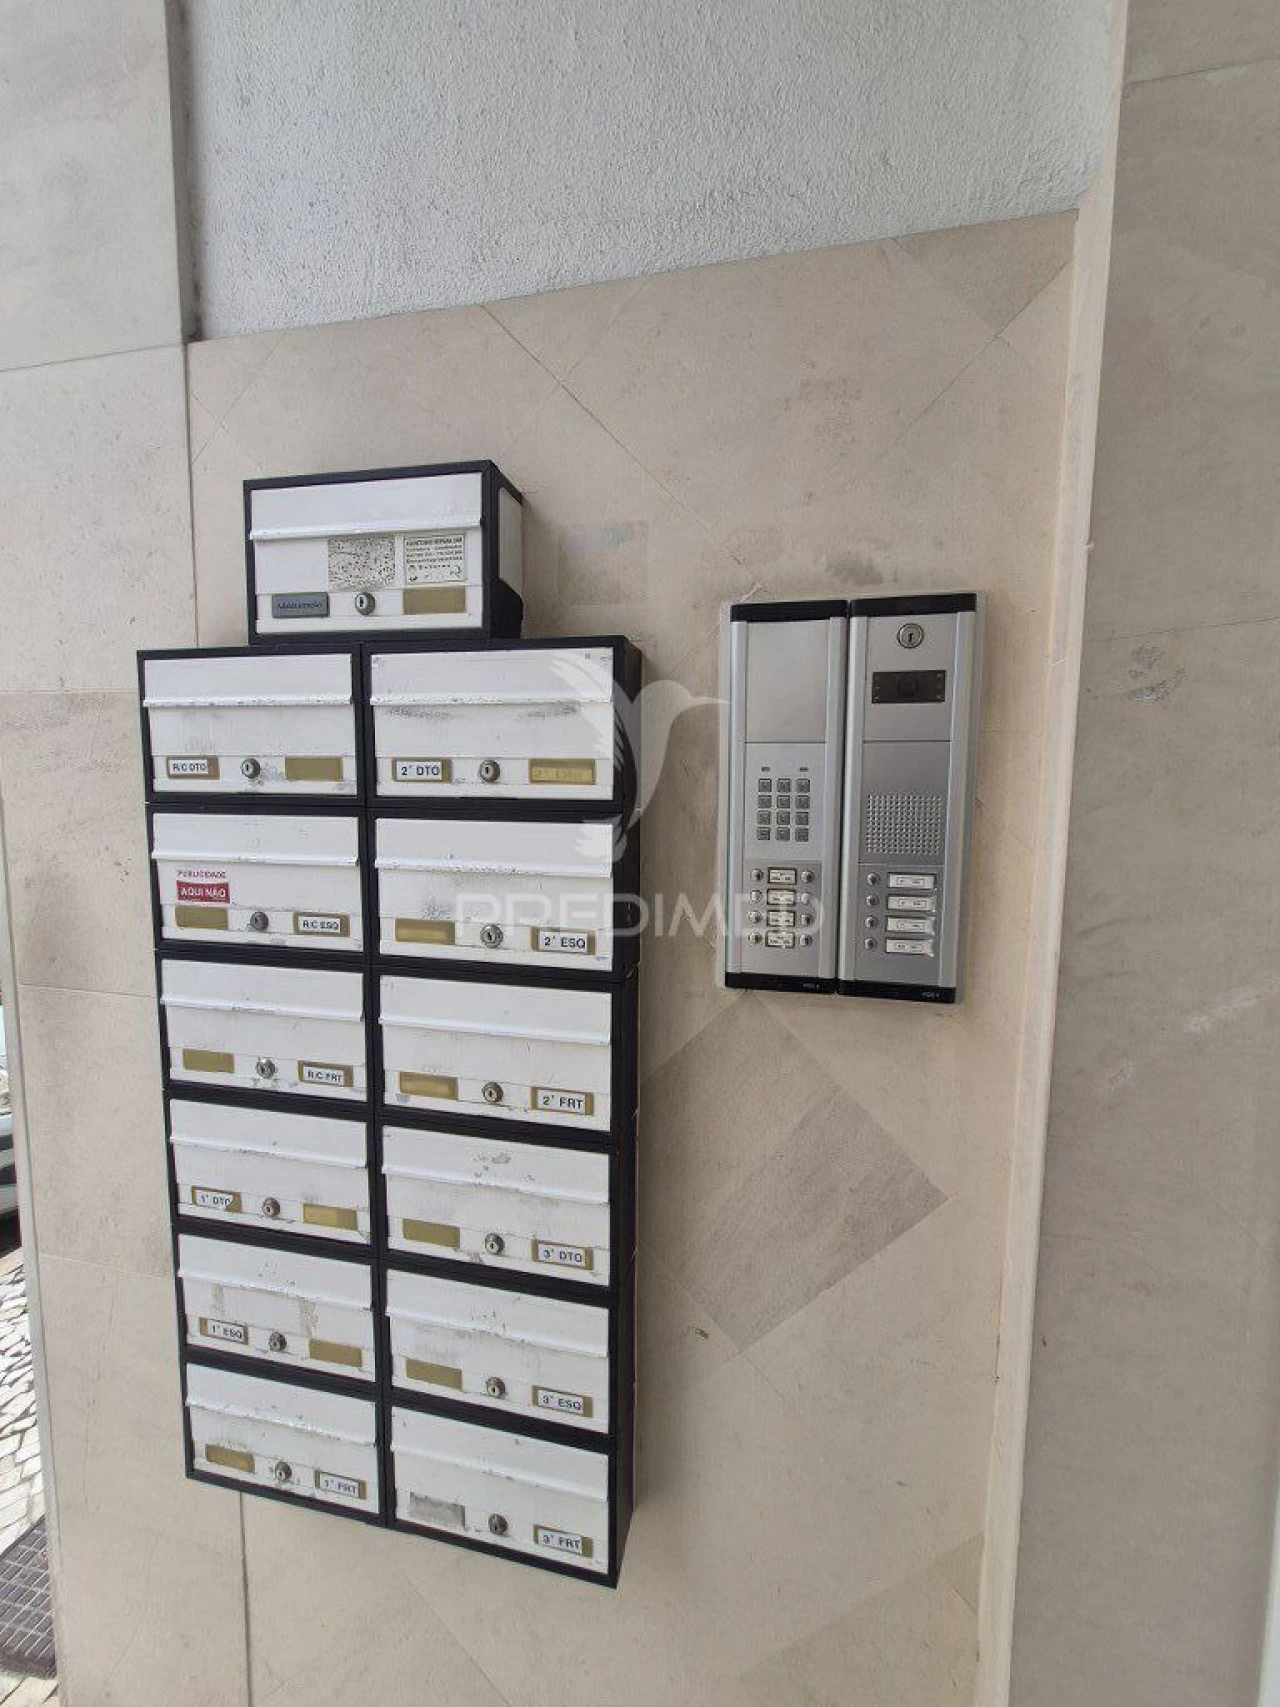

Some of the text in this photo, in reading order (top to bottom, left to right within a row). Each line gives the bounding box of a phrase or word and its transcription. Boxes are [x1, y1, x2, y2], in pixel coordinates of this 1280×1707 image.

[416, 765, 440, 776] DTO
[181, 886, 226, 898] AQUI NÃO
[560, 936, 586, 949] ESQ
[559, 1096, 584, 1109] FRT
[559, 1251, 583, 1263] DTO
[558, 1398, 582, 1411] ESQ
[558, 1536, 581, 1550] FRT
